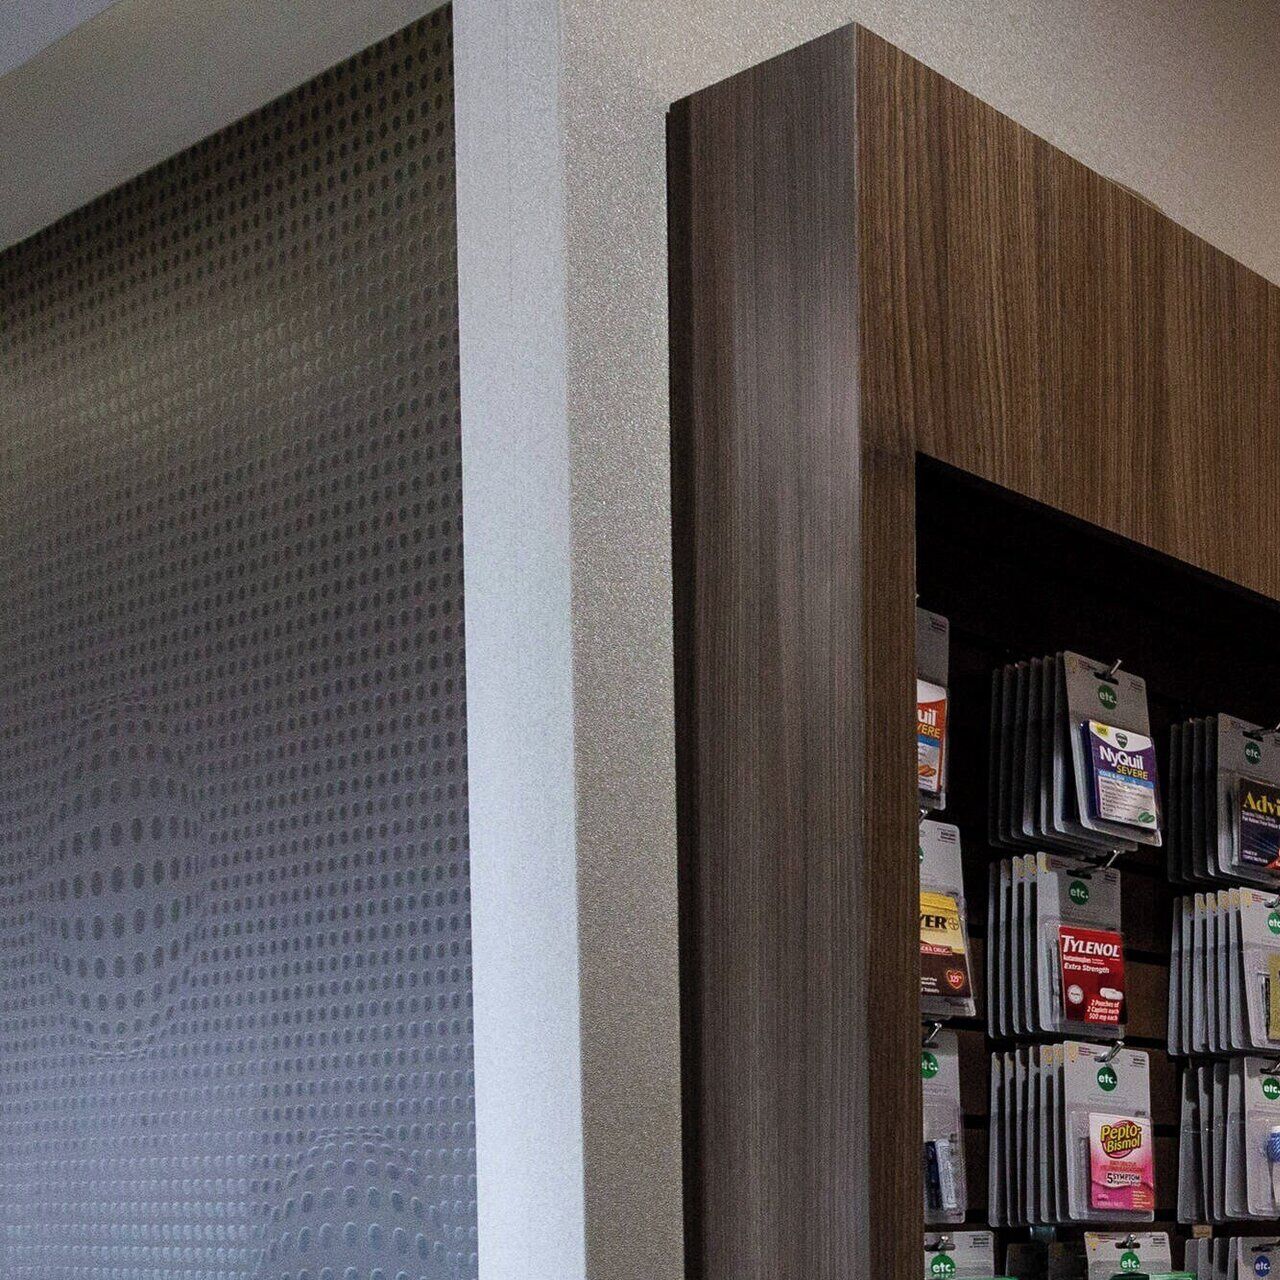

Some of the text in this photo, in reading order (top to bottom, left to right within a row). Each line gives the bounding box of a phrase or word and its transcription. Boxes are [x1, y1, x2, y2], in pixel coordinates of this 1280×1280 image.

[1099, 745, 1144, 770] NyQuil
[1116, 764, 1149, 780] SEVERE
[1061, 934, 1121, 958] TYLENOL
[1064, 963, 1110, 974] Extra Strength
[1101, 1123, 1142, 1141] Pepto-
[1105, 1138, 1142, 1153] Bismol
